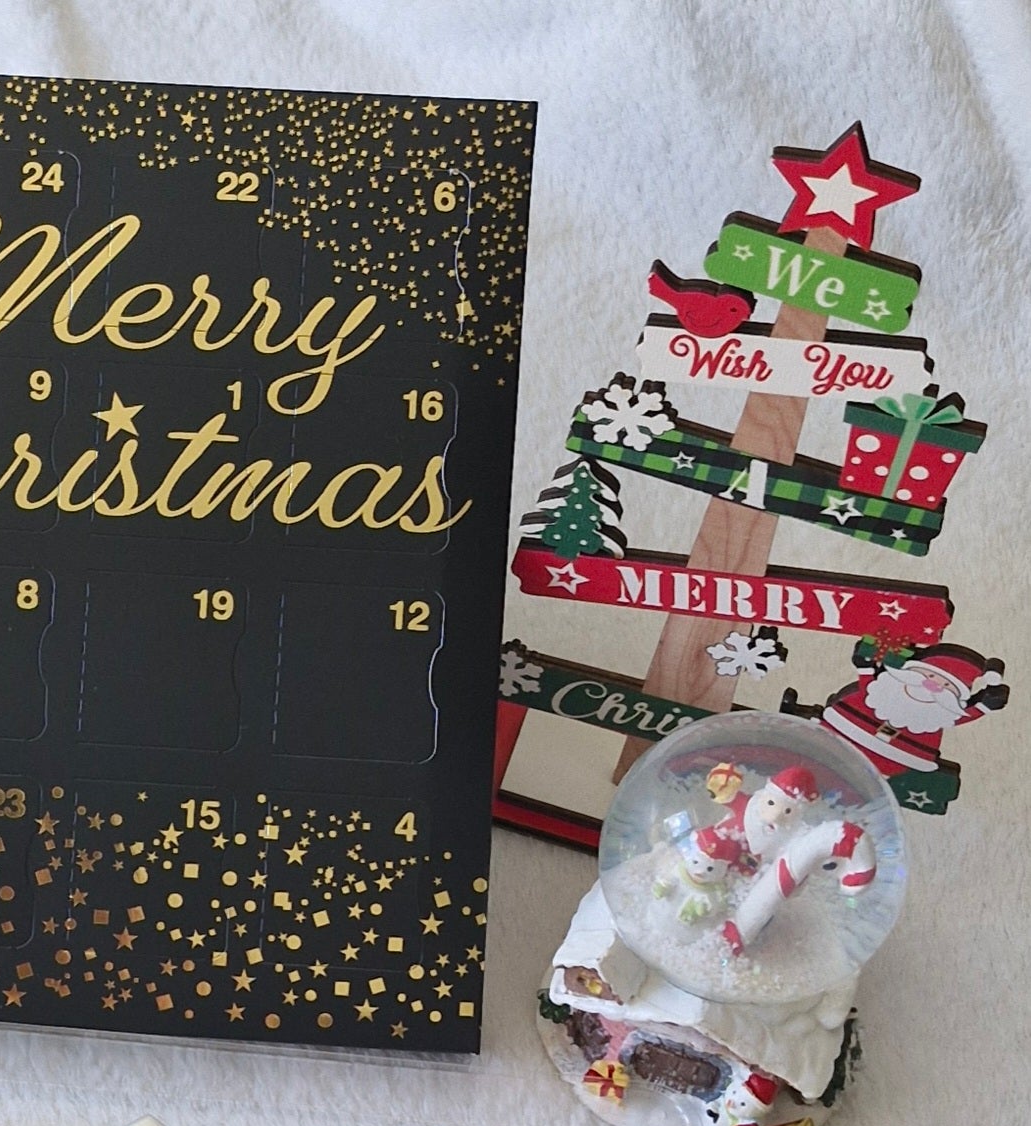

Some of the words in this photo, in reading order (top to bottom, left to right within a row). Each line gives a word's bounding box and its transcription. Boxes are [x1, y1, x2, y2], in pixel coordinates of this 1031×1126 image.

[21, 161, 64, 192] 24
[216, 171, 259, 201] 22
[434, 181, 456, 212] 6
[765, 245, 846, 308] We
[670, 334, 772, 382] Wish
[804, 343, 895, 394] You
[30, 370, 52, 400] 9
[227, 381, 242, 410] 1
[403, 390, 443, 421] 16
[719, 460, 769, 511] A
[17, 579, 38, 609] 8
[193, 589, 234, 620] 19
[616, 566, 856, 631] MERRY
[389, 601, 430, 631] 12
[181, 799, 220, 830] 15
[395, 812, 416, 842] 4
